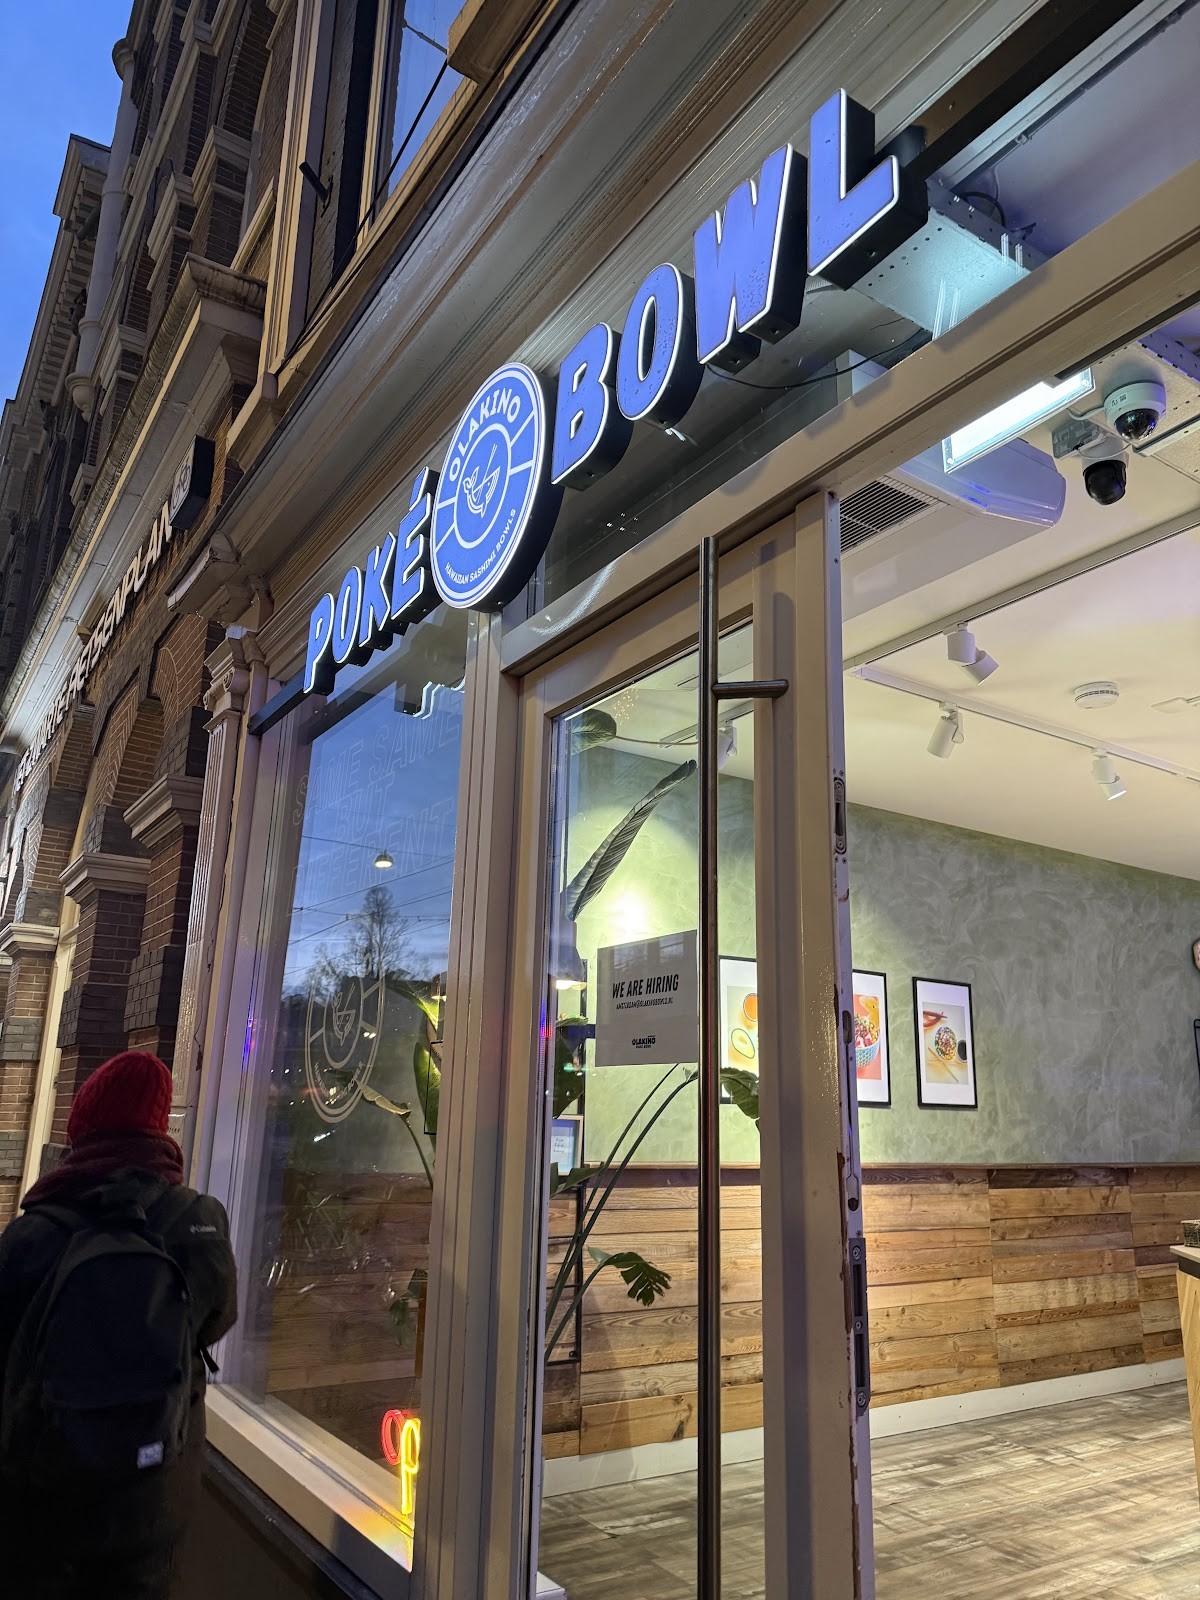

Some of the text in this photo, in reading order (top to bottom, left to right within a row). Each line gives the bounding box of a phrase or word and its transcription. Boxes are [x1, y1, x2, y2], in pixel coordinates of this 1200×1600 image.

[303, 87, 899, 694] POKÉ BOWL
[448, 387, 521, 482] OLAKINO
[444, 508, 516, 585] HAWAIIAN SASHIMI BOWLS
[612, 974, 679, 999] WE ARE HIRING
